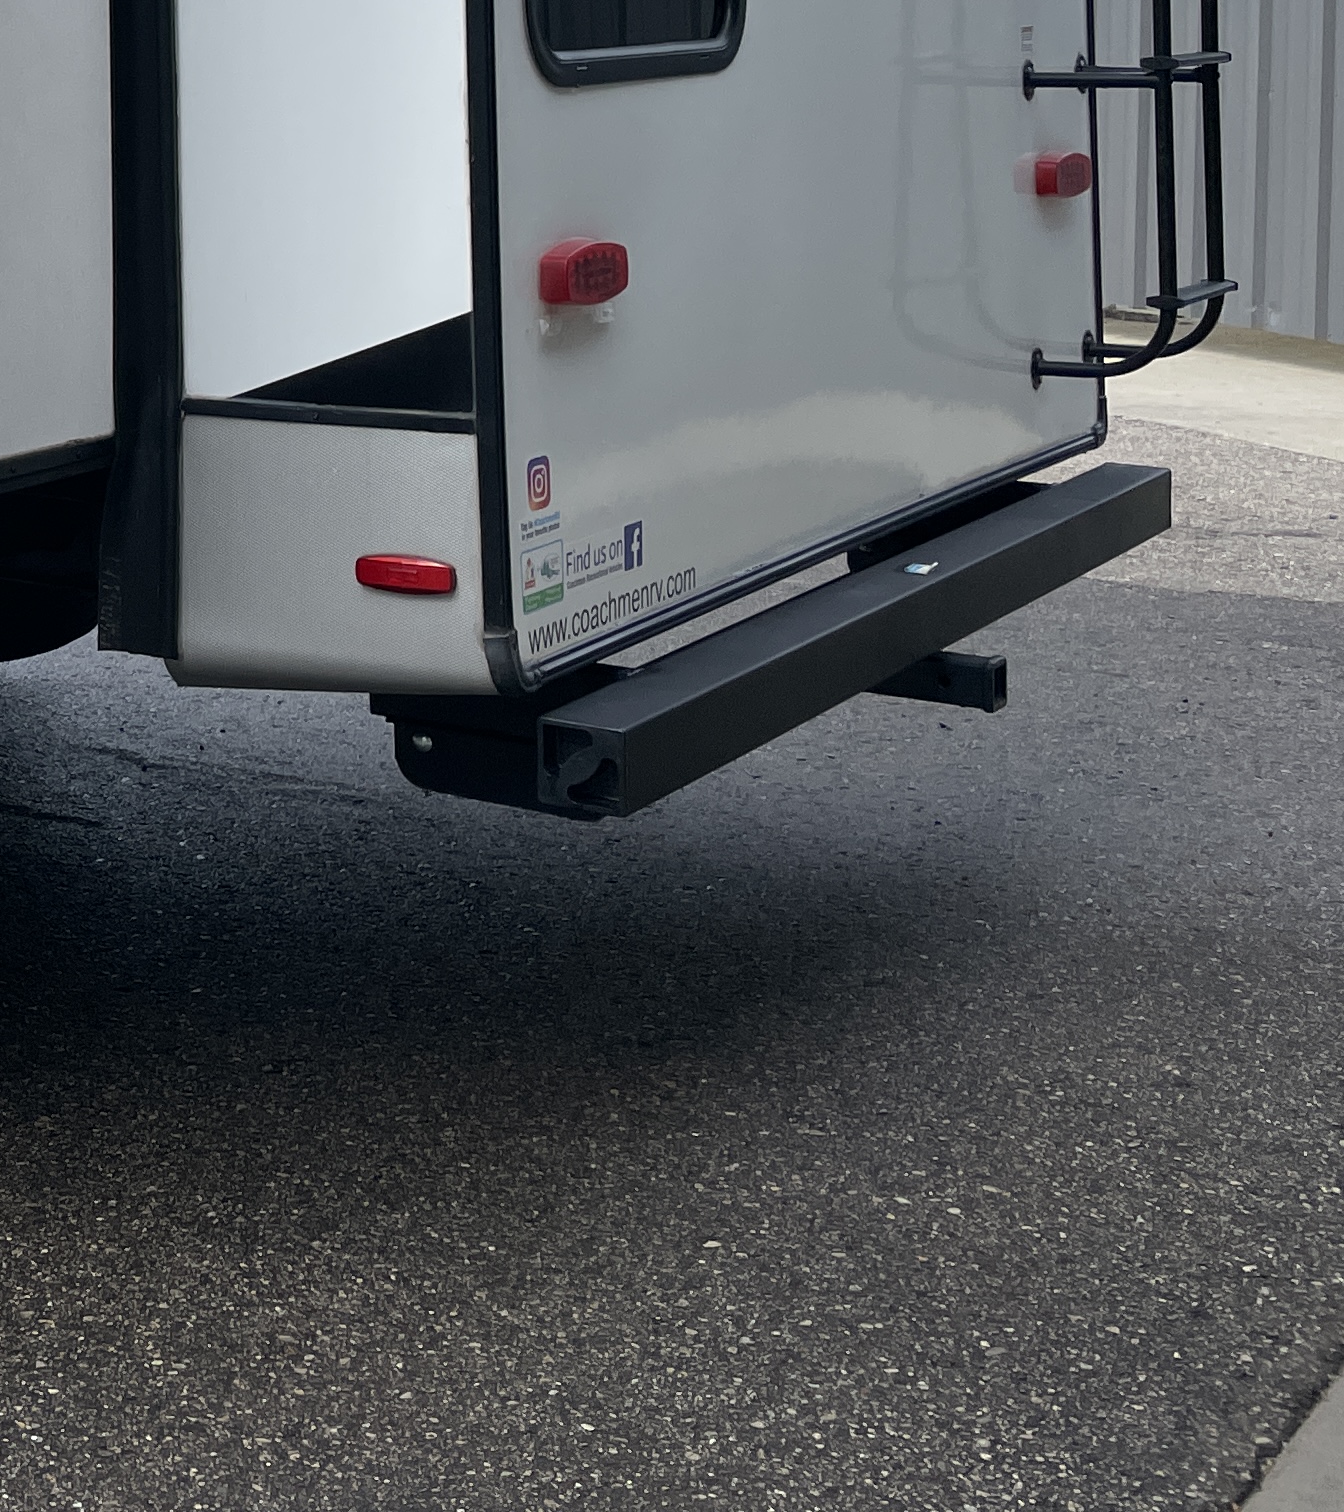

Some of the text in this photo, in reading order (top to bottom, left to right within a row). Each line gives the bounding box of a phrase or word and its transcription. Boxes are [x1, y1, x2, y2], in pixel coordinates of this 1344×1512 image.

[565, 542, 591, 577] Find
[593, 545, 607, 567] us
[608, 539, 624, 561] on
[528, 566, 697, 655] www.coachmenrv.com
